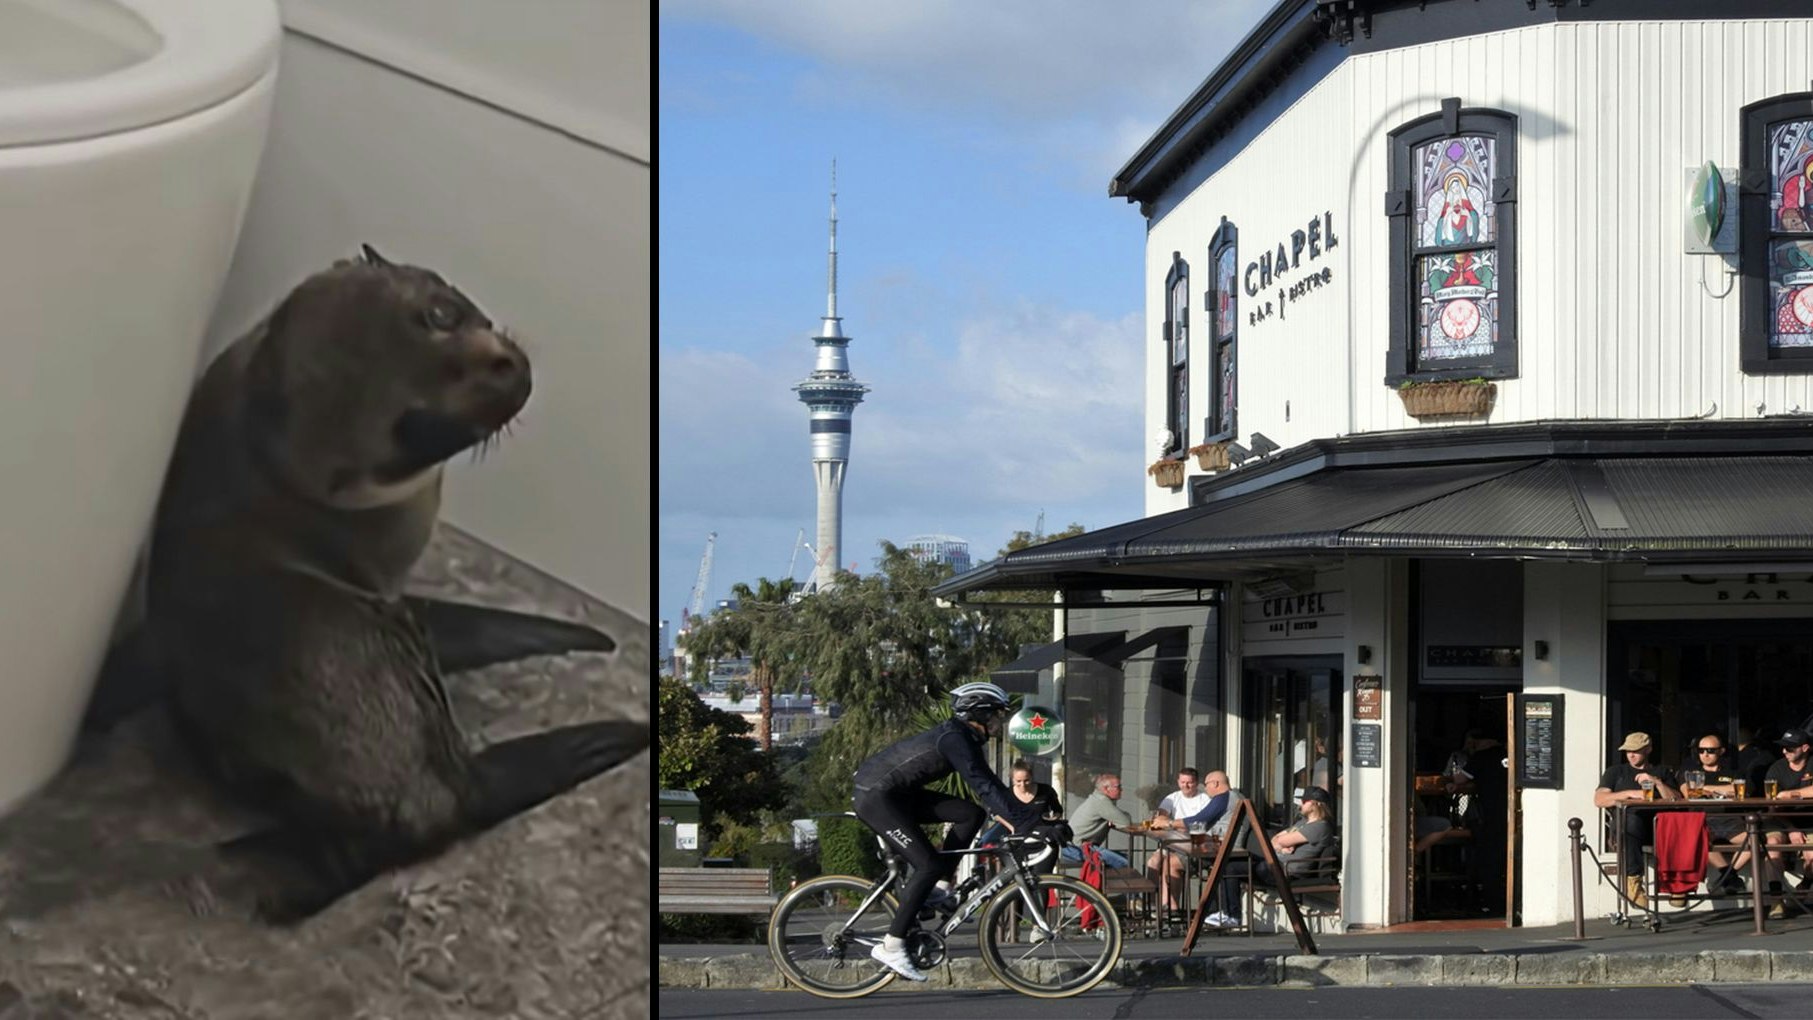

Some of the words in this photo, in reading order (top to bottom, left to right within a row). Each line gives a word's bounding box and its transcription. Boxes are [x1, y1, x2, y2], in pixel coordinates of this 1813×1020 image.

[1244, 210, 1339, 297] CHAPEL
[1249, 301, 1273, 327] BAR
[1289, 266, 1332, 303] BISTRO
[1263, 593, 1325, 617] CHAPEL
[1717, 589, 1790, 600] BAR
[1015, 732, 1059, 740] Heineken
